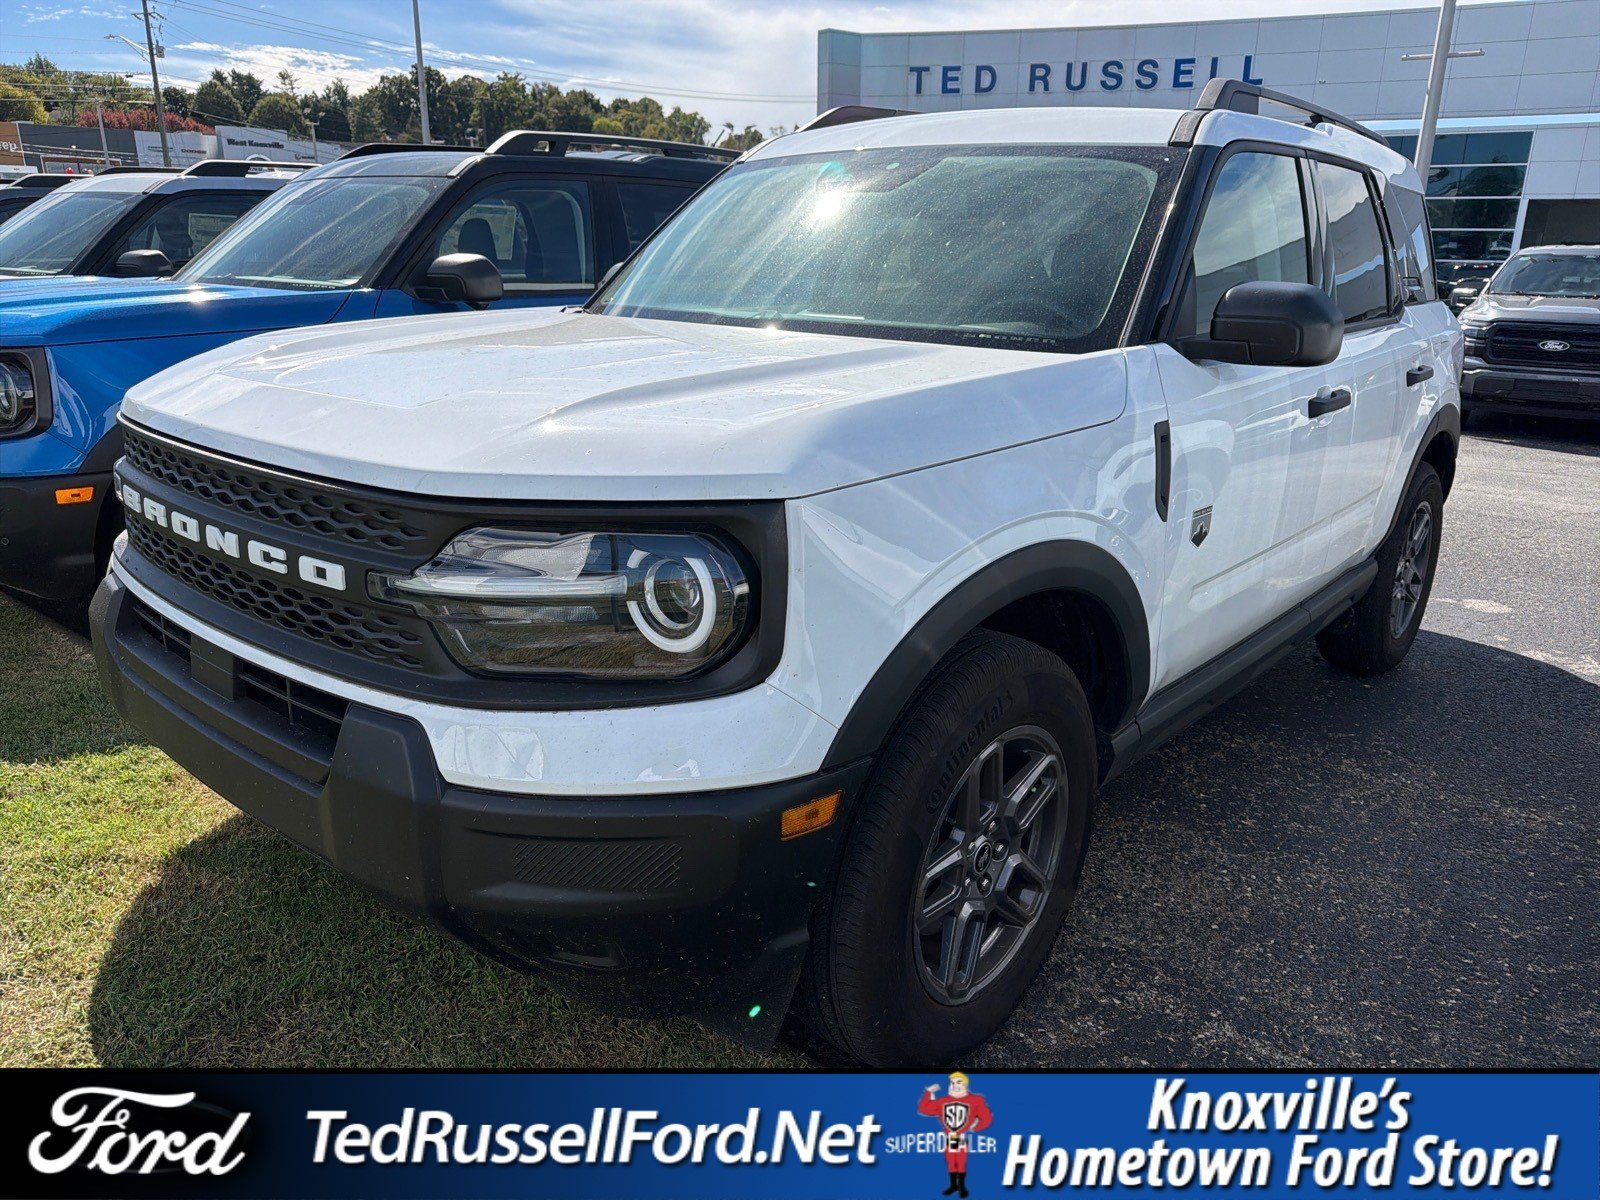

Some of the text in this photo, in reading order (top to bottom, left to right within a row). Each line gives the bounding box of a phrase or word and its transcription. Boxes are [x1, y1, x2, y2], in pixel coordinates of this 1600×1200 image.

[909, 65, 998, 94] TED
[227, 138, 284, 149] West Knoxville
[1543, 341, 1566, 350] Ford
[122, 484, 346, 591] BRONCO
